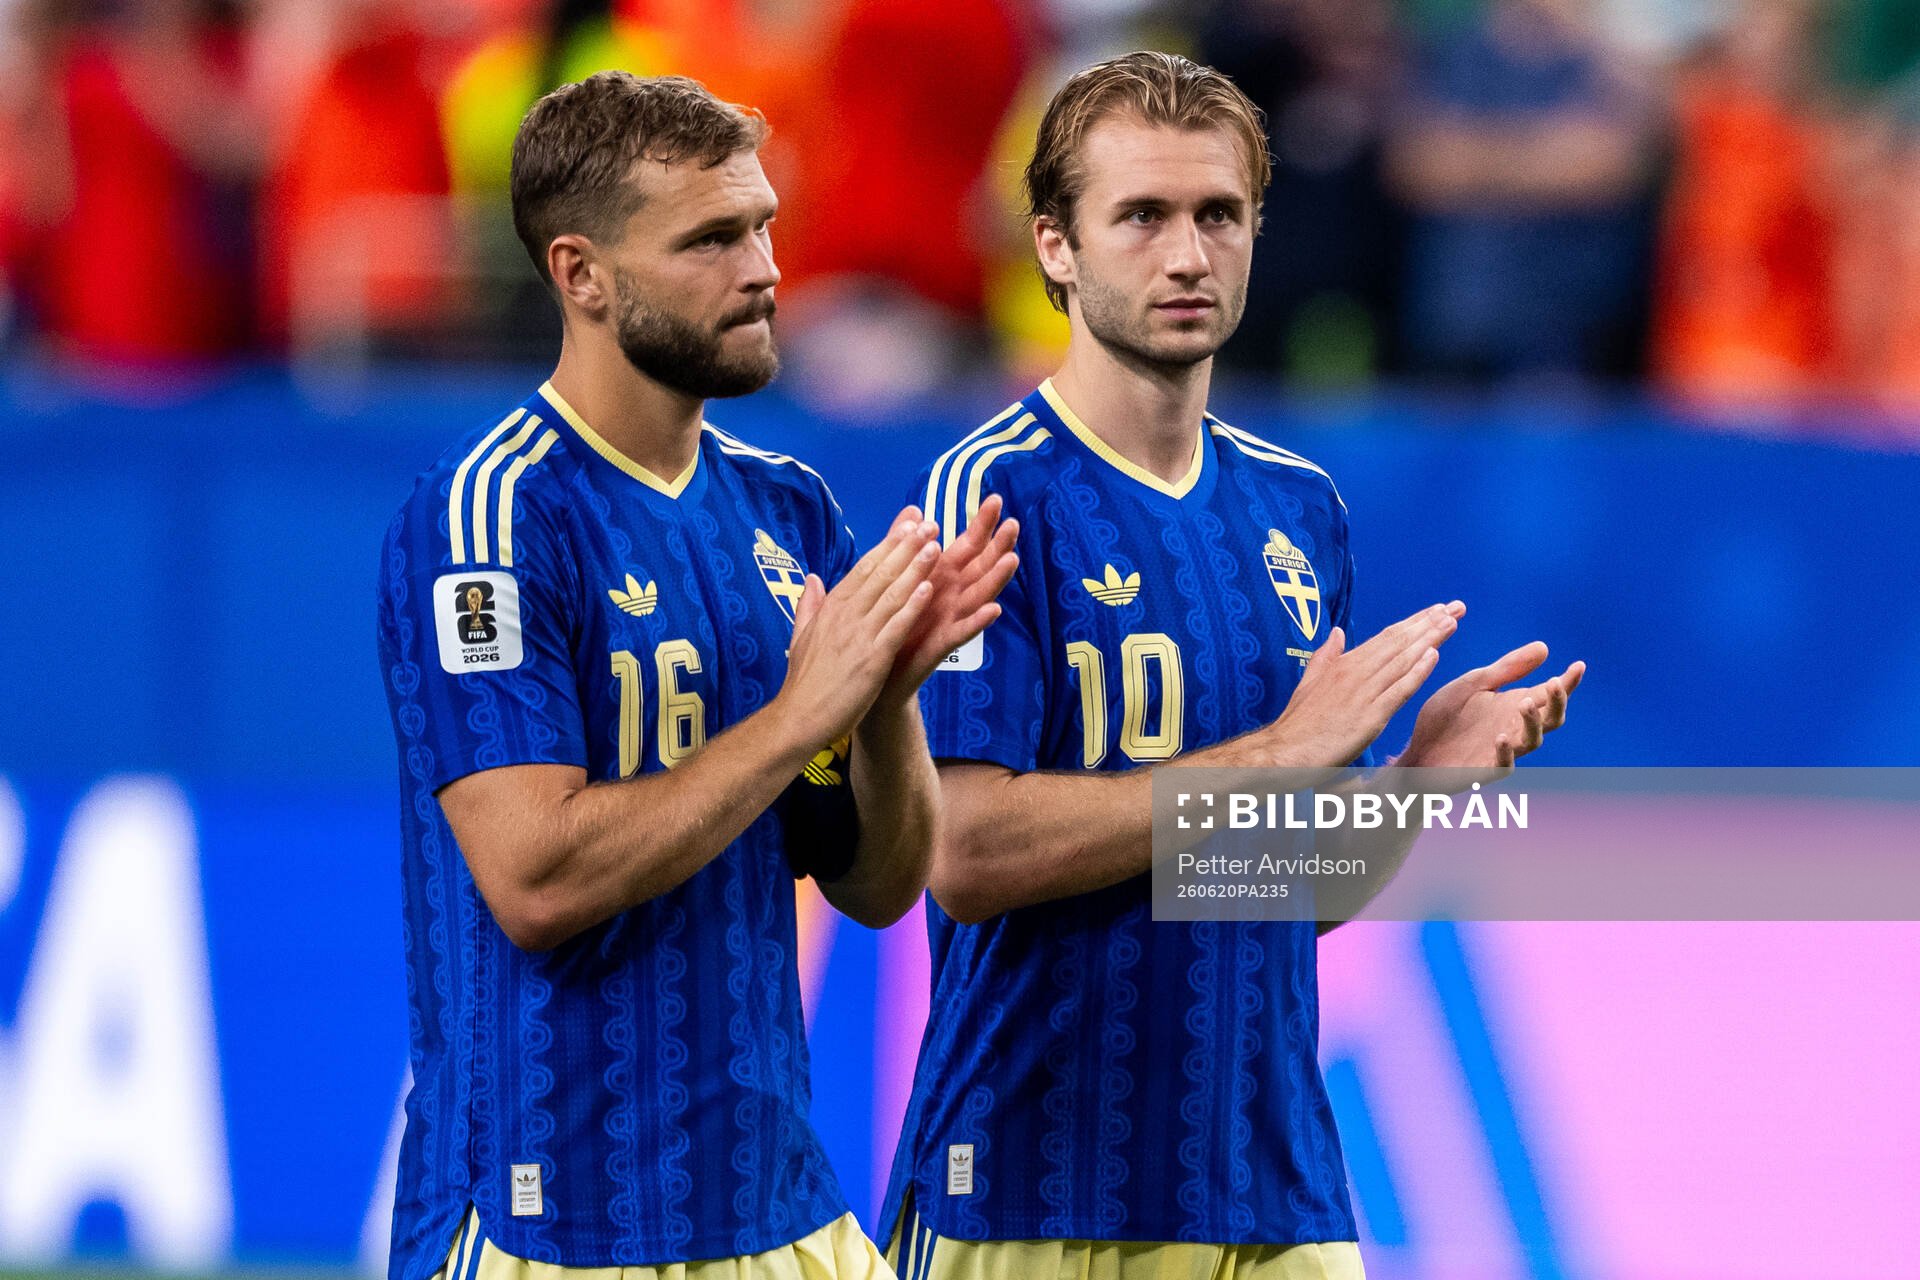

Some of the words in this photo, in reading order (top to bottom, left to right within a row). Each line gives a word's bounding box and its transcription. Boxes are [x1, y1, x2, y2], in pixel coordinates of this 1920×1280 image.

[1272, 557, 1306, 570] SVERIGE
[468, 631, 487, 640] FIFA
[463, 653, 500, 664] 2026
[1066, 633, 1185, 769] 10
[611, 639, 707, 780] 16
